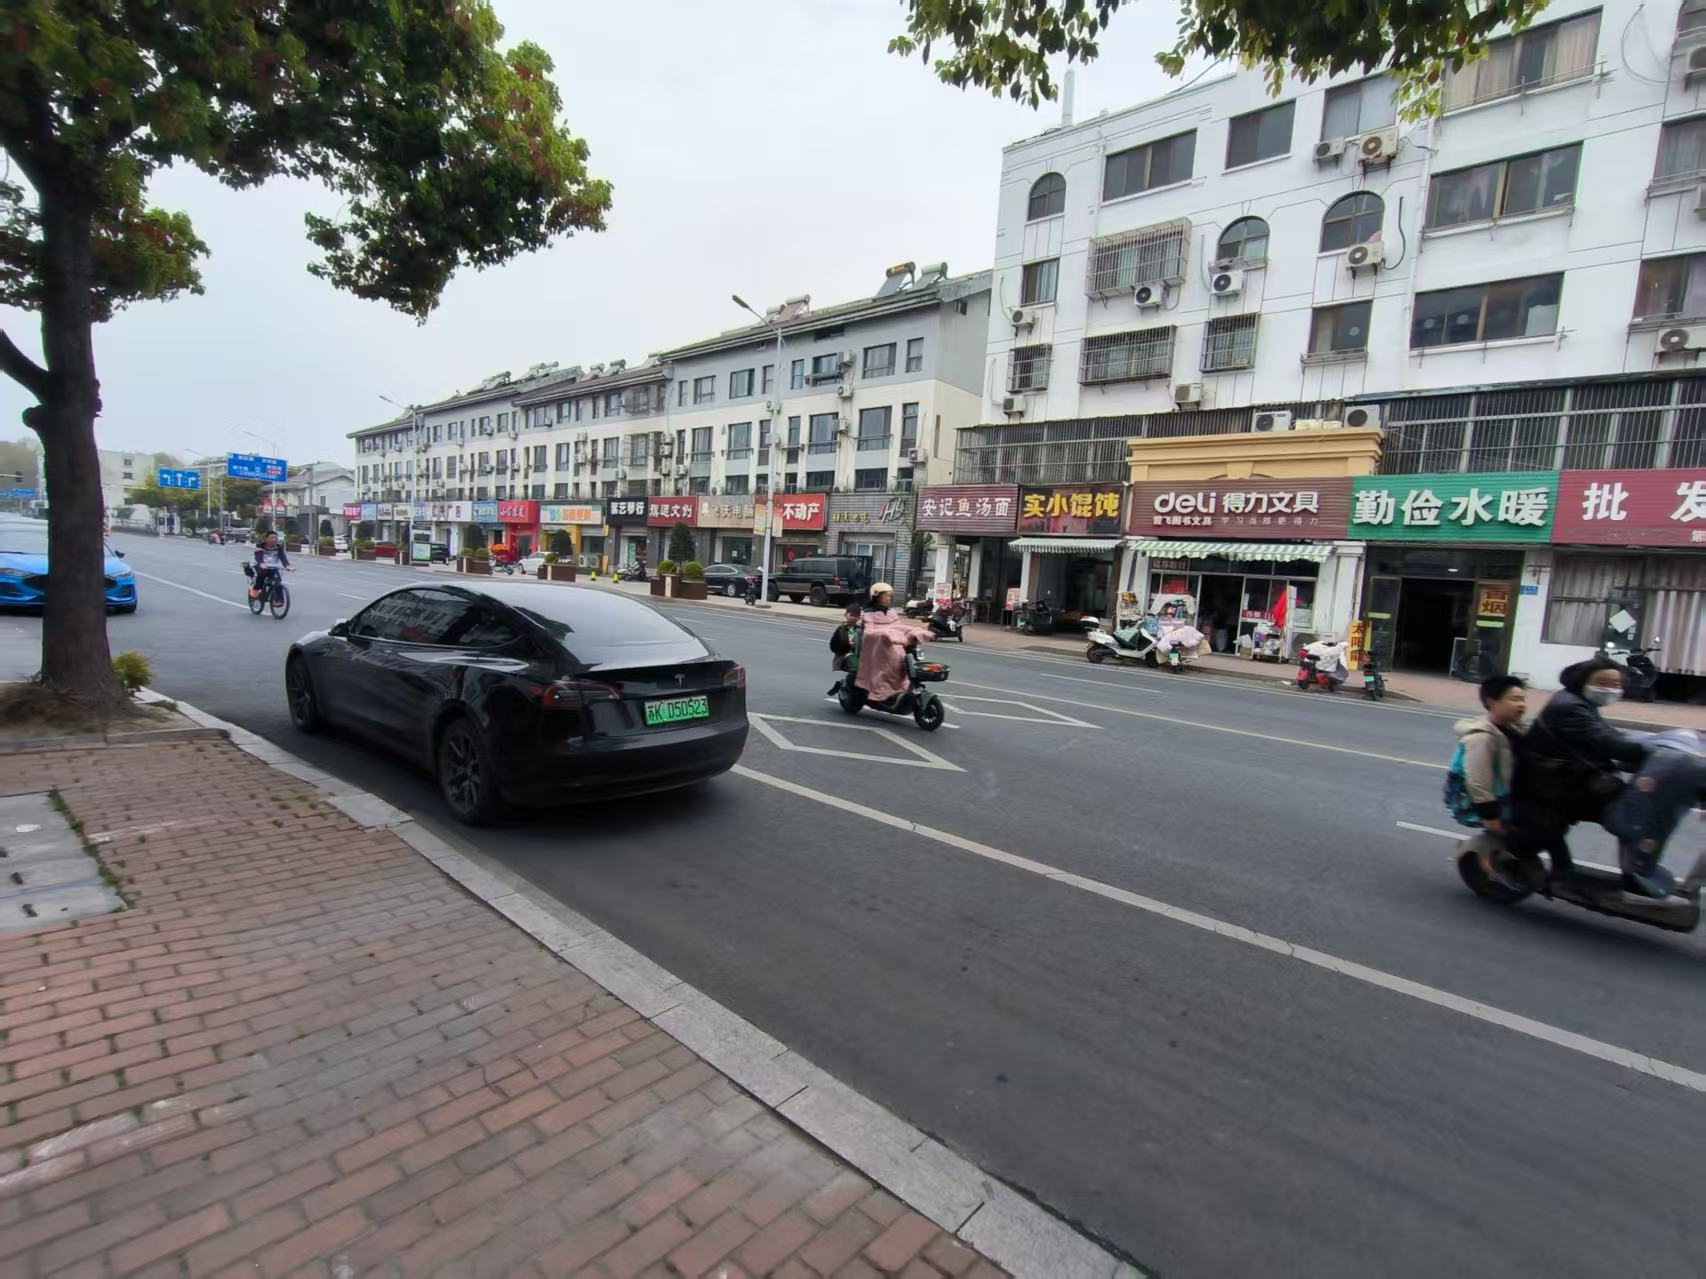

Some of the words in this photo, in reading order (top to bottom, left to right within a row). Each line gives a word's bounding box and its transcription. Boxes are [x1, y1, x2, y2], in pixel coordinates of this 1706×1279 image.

[783, 502, 820, 520] 不动产
[922, 497, 1011, 516] 安记鱼汤面
[1024, 493, 1120, 517] 实小馄饨
[1153, 492, 1216, 514] deli
[1222, 491, 1319, 514] 得力文具
[1353, 488, 1549, 526] 勤俭水暖
